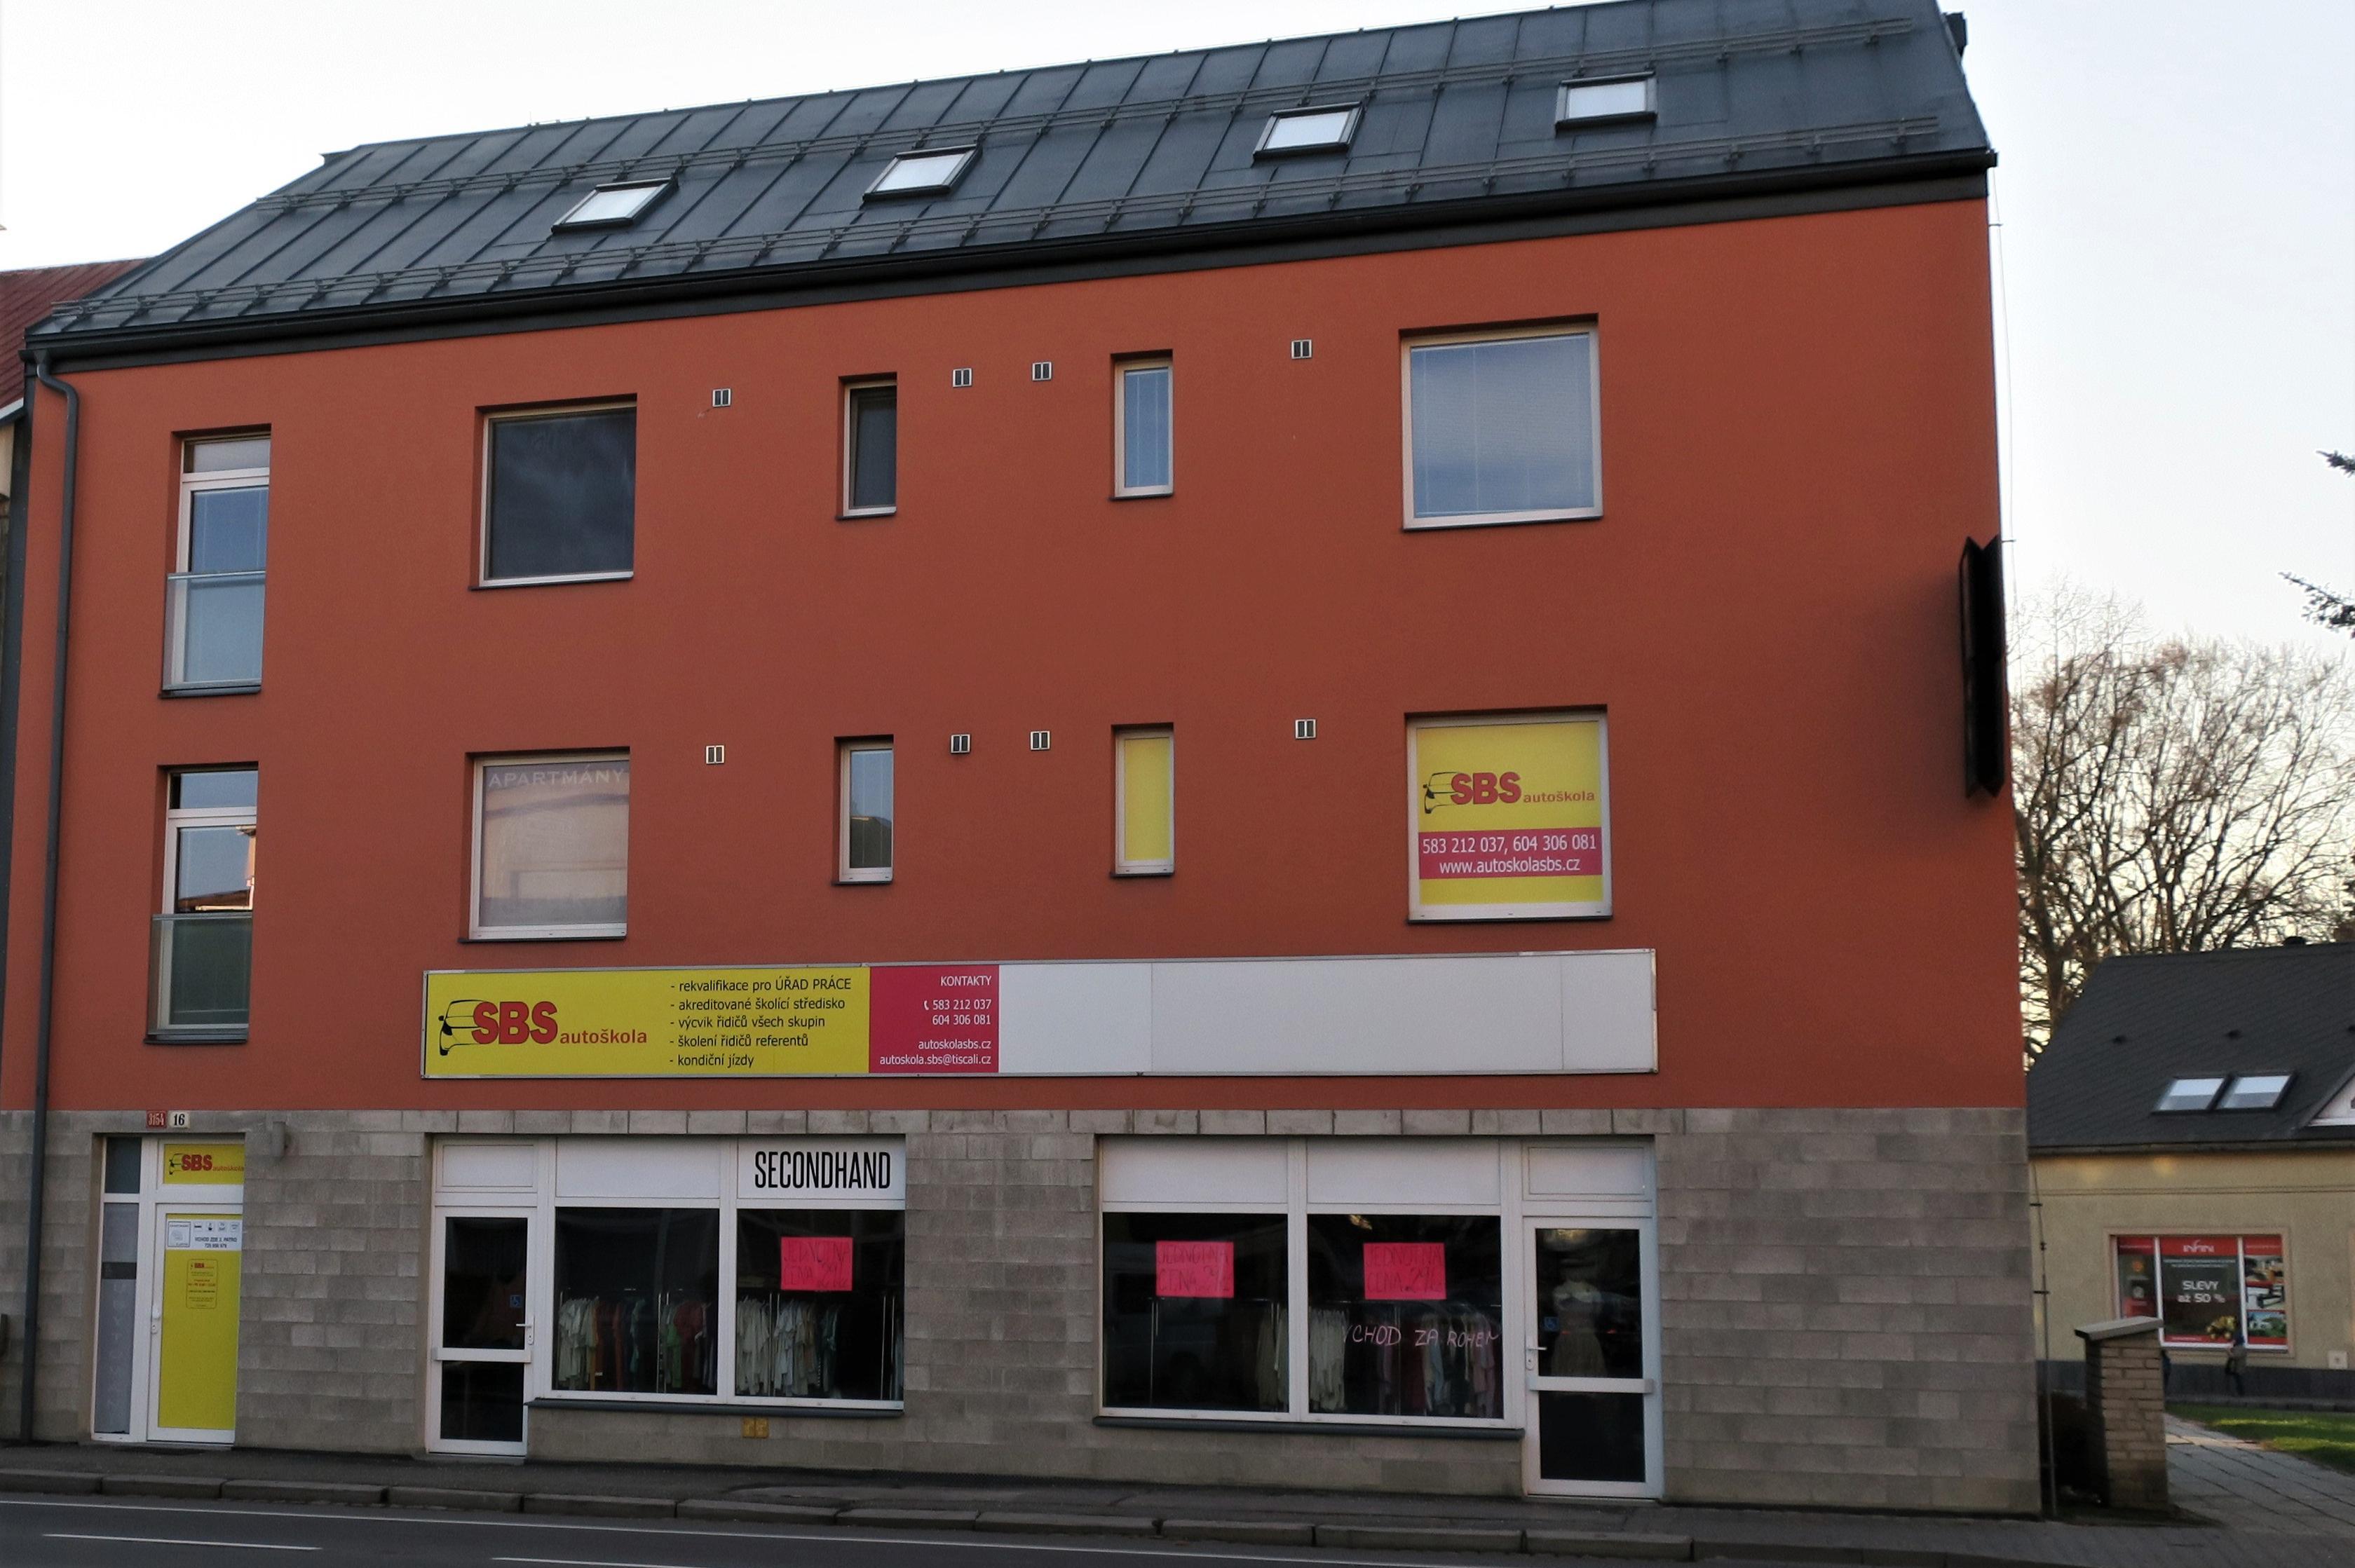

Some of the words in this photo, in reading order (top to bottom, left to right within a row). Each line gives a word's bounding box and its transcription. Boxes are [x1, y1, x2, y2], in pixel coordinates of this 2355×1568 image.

[489, 765, 623, 787] APARTMÁNY
[1451, 772, 1522, 805] SBS
[1523, 791, 1595, 803] autoškola
[1423, 838, 1446, 854] 583
[1451, 837, 1475, 852] 212
[1481, 836, 1507, 854] 037,
[1513, 836, 1538, 852] 604
[1543, 835, 1568, 850] 306
[1572, 834, 1596, 850] 081
[1439, 857, 1580, 873] www.autoskolasbs.cz
[679, 980, 749, 992] rekvalifikace
[752, 981, 771, 993] pro
[775, 976, 808, 990] ÚŘAD
[813, 975, 851, 990] PRÁCE
[940, 976, 991, 986] KONTAKTY
[679, 997, 752, 1010] akreditované
[755, 997, 789, 1009] školící
[793, 997, 845, 1009] středisko
[932, 1000, 950, 1010] 583
[953, 999, 970, 1009] 212
[974, 999, 991, 1009] 037
[471, 1001, 558, 1044] SBS
[559, 1029, 647, 1044] autoškola
[679, 1016, 712, 1030] výcvik
[717, 1015, 747, 1028] řidičů
[752, 1015, 784, 1028] všech
[788, 1016, 824, 1030] skupin
[932, 1015, 949, 1025] 604
[953, 1015, 970, 1025] 306
[974, 1015, 991, 1025] 081
[678, 1035, 717, 1047] školení
[721, 1035, 751, 1047] řidičů
[756, 1033, 808, 1047] referentů
[918, 1039, 991, 1049] autoskolasbs.cz
[678, 1054, 724, 1066] kondiční
[728, 1054, 754, 1068] jízdy
[880, 1054, 991, 1065] autoskola.sbs@tiscali.cz
[148, 1113, 164, 1126] 3154
[174, 1113, 185, 1126] 16
[182, 1154, 212, 1171] SBS
[755, 1151, 890, 1189] SECONDHAND
[2182, 1281, 2219, 1290] SLEVY
[2193, 1293, 2212, 1302] 50
[1415, 1329, 1438, 1347] ZA
